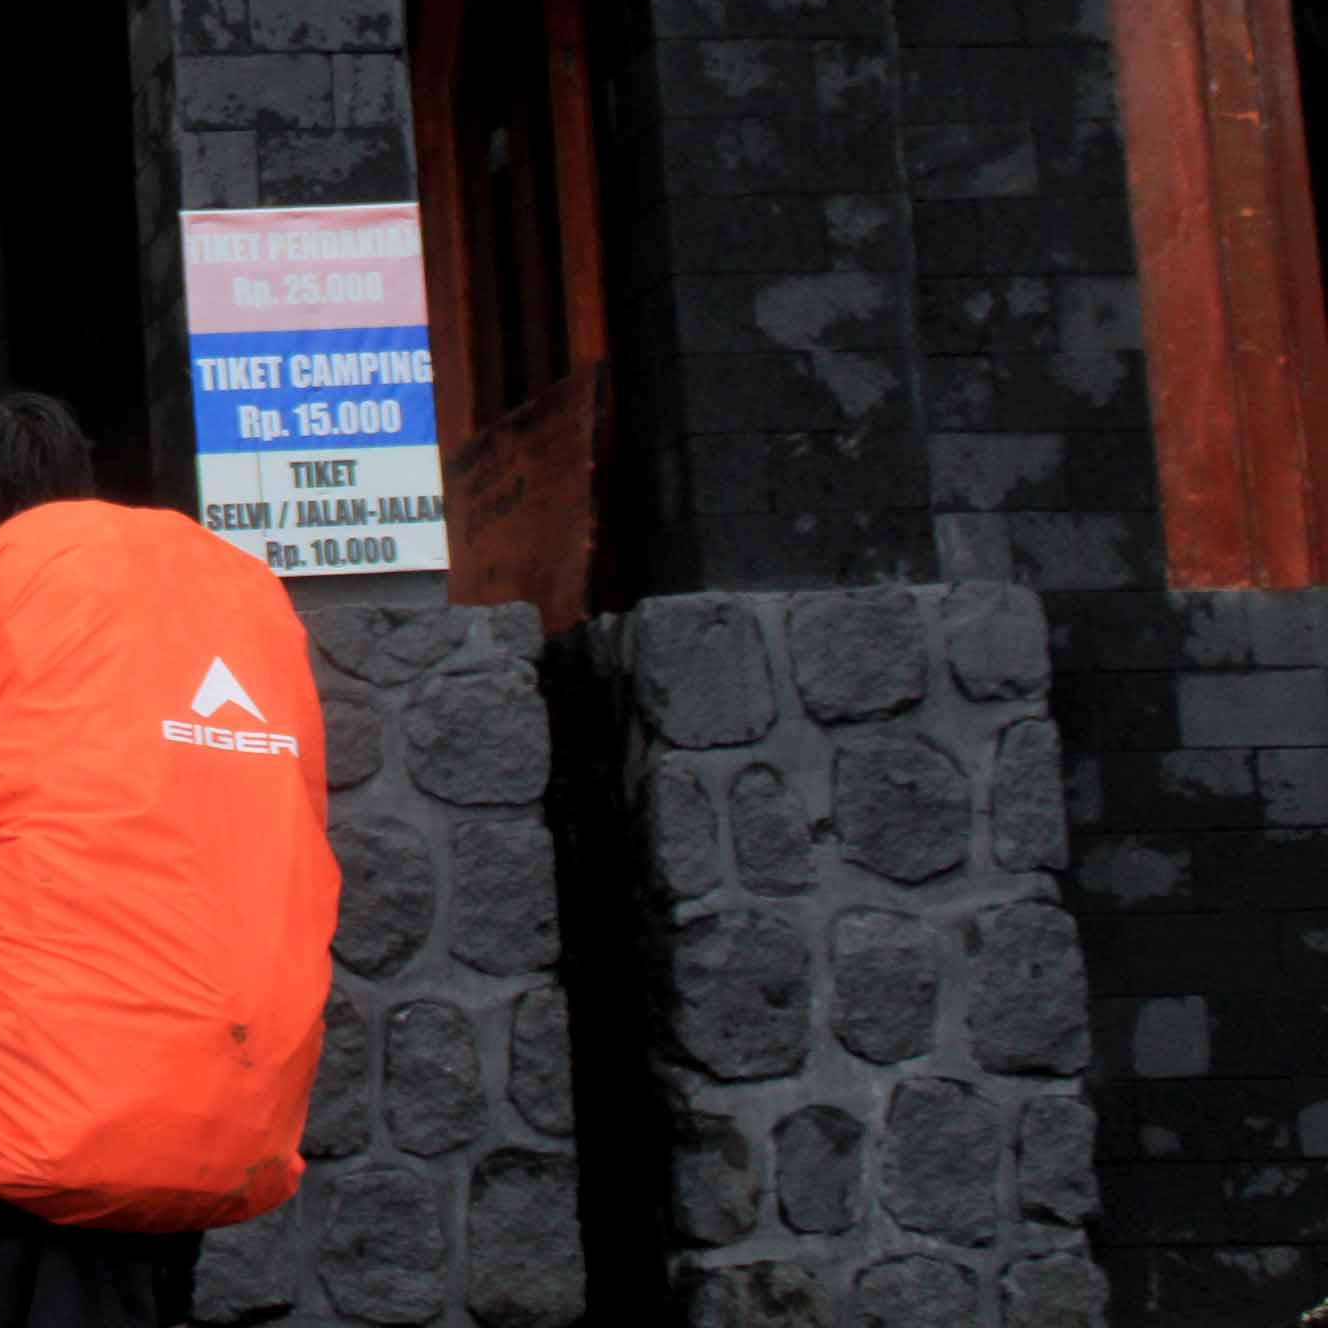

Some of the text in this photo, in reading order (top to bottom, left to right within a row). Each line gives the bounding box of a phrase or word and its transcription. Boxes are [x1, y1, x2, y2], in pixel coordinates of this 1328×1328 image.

[191, 231, 262, 265] TIKET
[233, 270, 385, 309] Rp. 25.000
[197, 349, 434, 391] TIKET CAMPING
[238, 399, 403, 441] Rp. 15.000
[290, 459, 358, 489] TIKET
[206, 501, 272, 532] SELVI
[295, 494, 445, 529] JALAN-JALAN
[265, 536, 398, 569] Rp. 10.000
[161, 719, 300, 759] EIGER
